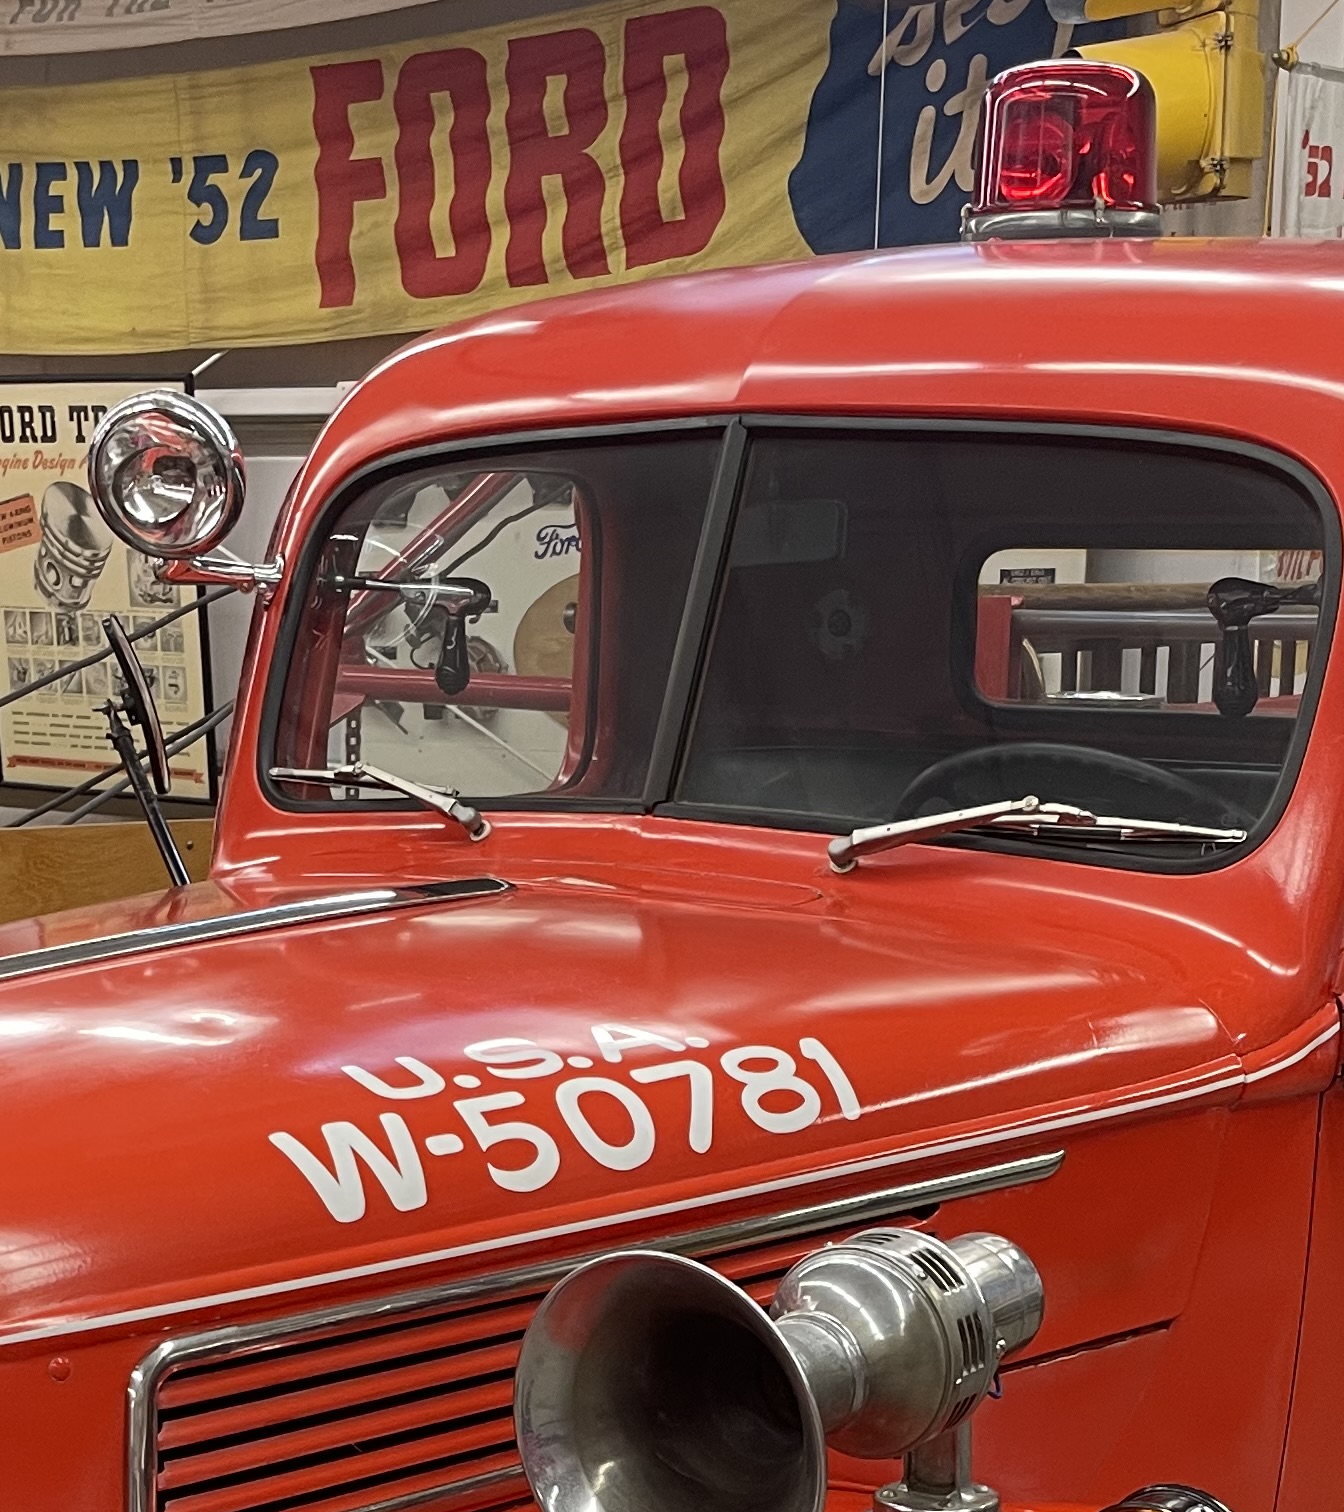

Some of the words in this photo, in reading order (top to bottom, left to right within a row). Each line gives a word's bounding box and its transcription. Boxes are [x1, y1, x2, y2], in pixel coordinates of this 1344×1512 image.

[168, 148, 281, 247] '52
[308, 5, 731, 310] FORD
[1301, 129, 1334, 198] '52
[32, 449, 77, 477] Design
[340, 1022, 710, 1101] U.S.A.
[267, 1036, 862, 1224] W-50781
